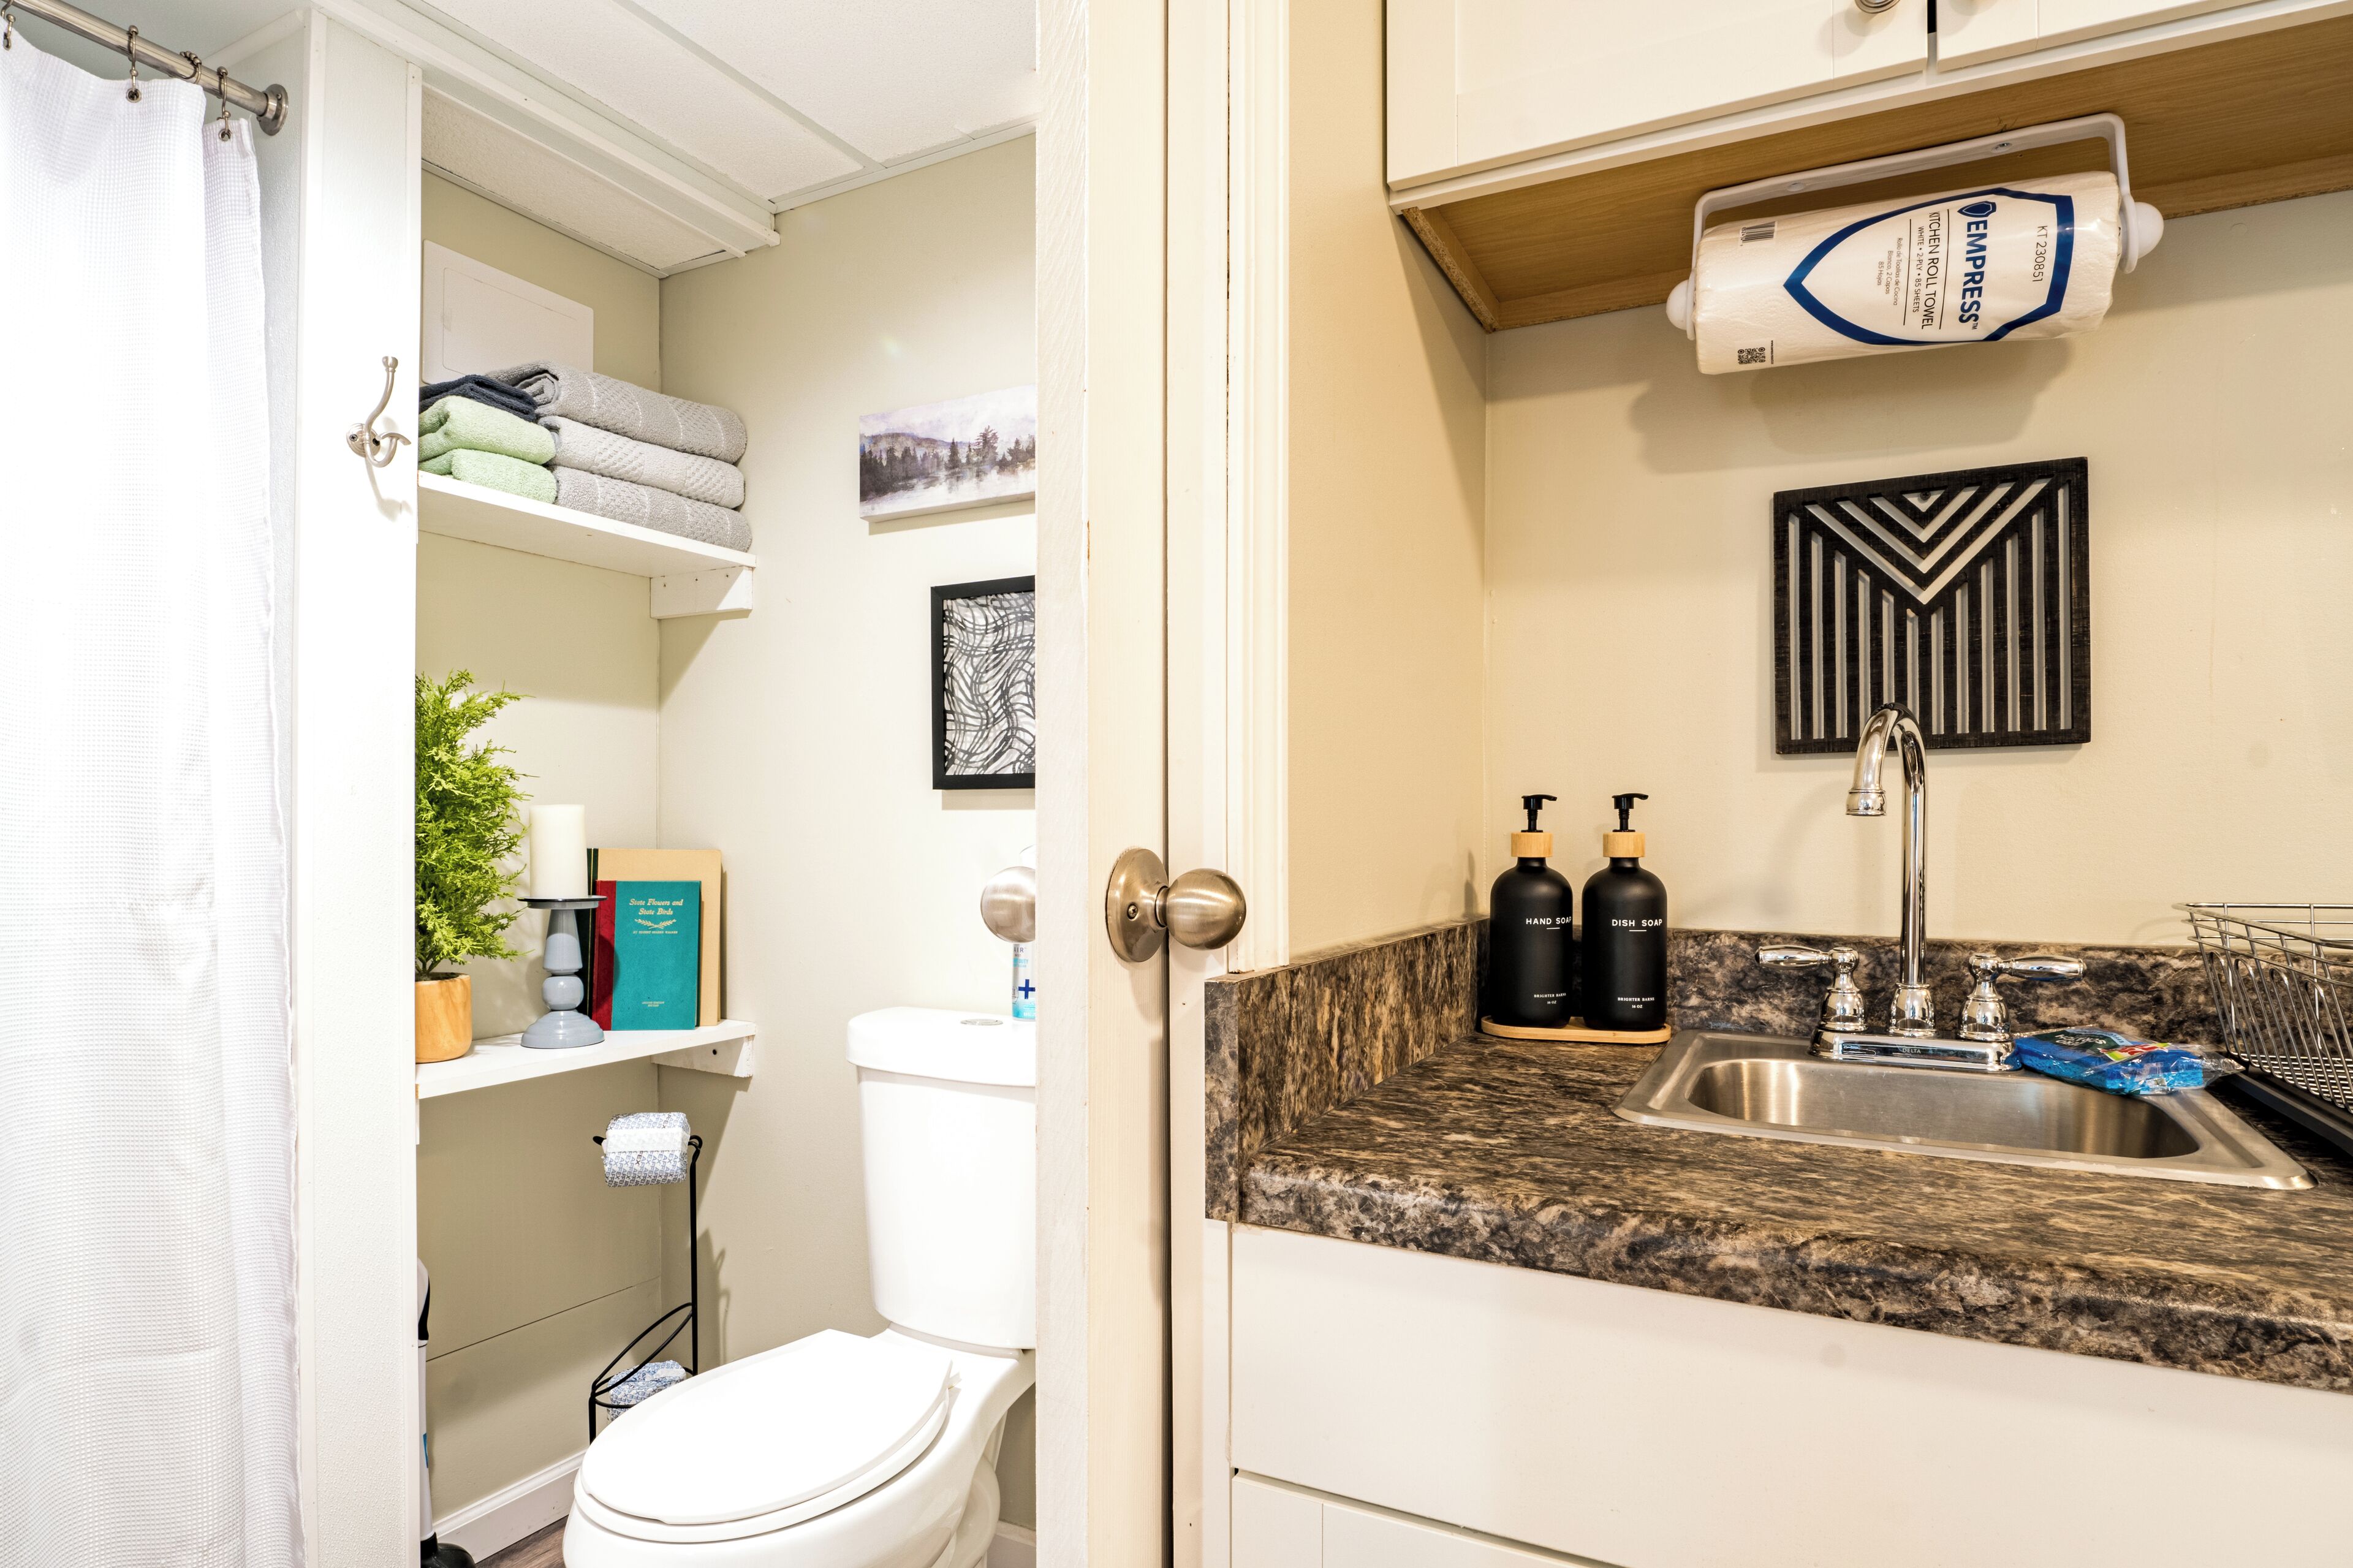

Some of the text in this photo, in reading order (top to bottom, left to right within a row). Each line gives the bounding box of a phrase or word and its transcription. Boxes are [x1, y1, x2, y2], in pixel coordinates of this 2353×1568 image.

[2032, 225, 2048, 282] KT 230851
[1922, 211, 1941, 329] KITCHEN ROLL TOWEL
[1914, 278, 1922, 287] 85
[1912, 289, 1921, 312] SHEETS
[1556, 916, 1572, 925] SOAP
[2055, 1034, 2107, 1044] SCRATCH
